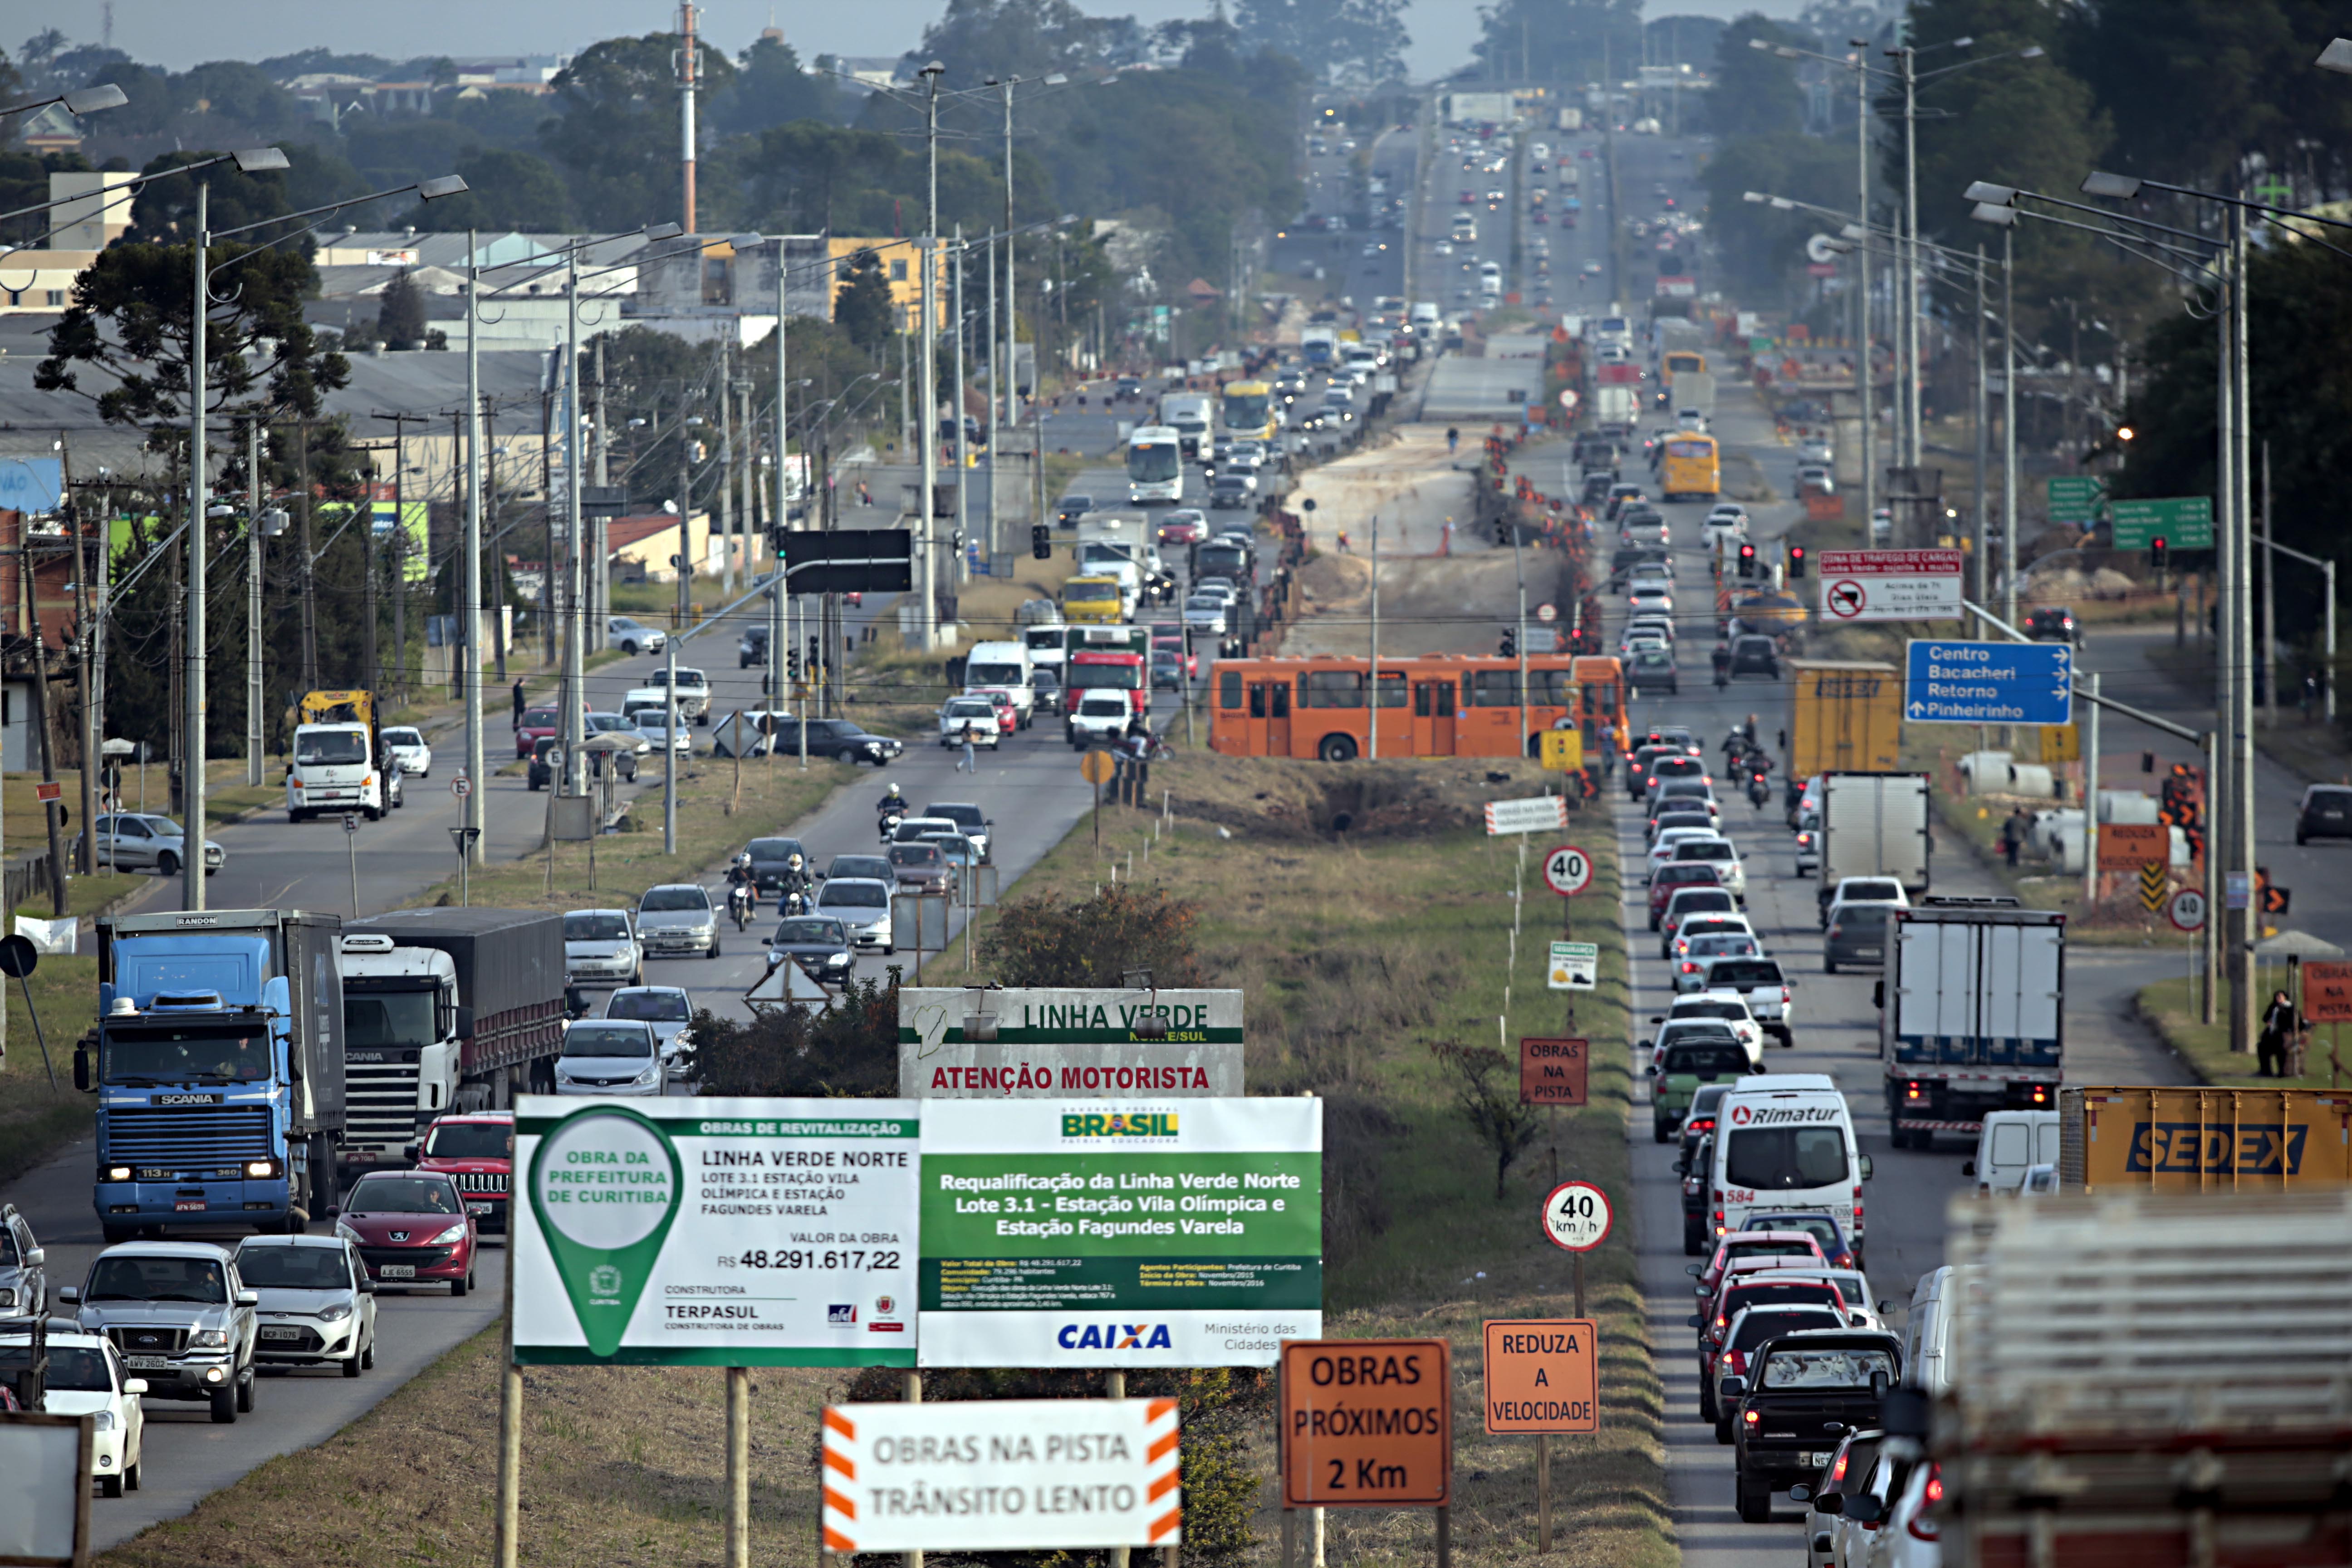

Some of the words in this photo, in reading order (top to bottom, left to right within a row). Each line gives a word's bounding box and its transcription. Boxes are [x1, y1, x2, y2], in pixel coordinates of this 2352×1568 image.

[1929, 646, 1989, 662] Centro
[1929, 665, 2016, 680] Bacacheri
[1928, 683, 1997, 698] Retorno
[1927, 701, 2024, 719] Pinheirinho
[1553, 856, 1582, 877] 40
[2178, 902, 2198, 914] 40
[177, 917, 216, 926] RANDON
[1554, 946, 1593, 954] SEGURANÇA
[2312, 968, 2352, 979] OBRA
[1024, 1004, 1109, 1029] LINHA
[1119, 1005, 1207, 1029] VERDE
[345, 1053, 382, 1062] CANIA
[1530, 1044, 1578, 1058] OBRAS
[931, 1062, 1053, 1095] ATENÇÃO
[1062, 1066, 1210, 1089] MOTORISTA
[1544, 1066, 1564, 1078] NA
[162, 1095, 213, 1104] SCANIA
[1534, 1086, 1572, 1098] PISTA
[1752, 1108, 1840, 1125] Rimatur
[700, 1122, 753, 1135] OBRAS
[757, 1122, 778, 1135] DE
[782, 1120, 901, 1137] REVITALIZAÇÃO
[1063, 1114, 1178, 1136] BRASIL
[2136, 1129, 2299, 1169] SEDEX
[567, 1151, 621, 1164] OBRA
[626, 1151, 649, 1164] DA
[703, 1151, 764, 1166] LINHA
[772, 1151, 836, 1167] VERDE
[843, 1151, 908, 1167] NORTE
[142, 1169, 162, 1177] 113
[549, 1171, 667, 1184] PREFEITURA
[701, 1173, 734, 1184] LOTE
[738, 1173, 757, 1184] 3.1
[764, 1171, 824, 1186] ESTAÇÃO
[828, 1173, 859, 1184] VILA
[940, 1173, 1085, 1194] Requalificação
[1089, 1173, 1114, 1189] da
[1120, 1173, 1174, 1189] Linha
[1179, 1173, 1239, 1189] Verde
[1245, 1173, 1300, 1189] Norte
[548, 1191, 574, 1203] DE
[578, 1191, 668, 1203] CURITIBA
[701, 1186, 768, 1200] OLÍMPICA
[773, 1189, 779, 1200] E
[784, 1186, 845, 1202] ESTAÇÃO
[1727, 1189, 1755, 1203] 584
[701, 1205, 772, 1215] FAGUNDES
[776, 1205, 828, 1215] VARELA
[956, 1197, 999, 1213] Lote
[1004, 1197, 1035, 1212] 3.1
[1056, 1197, 1133, 1216] Estação
[1137, 1196, 1175, 1212] Vila
[1181, 1196, 1267, 1216] Olímpica
[1273, 1200, 1284, 1211] e
[1560, 1195, 1593, 1219] 40
[996, 1220, 1073, 1239] Estação
[1079, 1220, 1175, 1239] Fagundes
[1181, 1220, 1244, 1235] Varela
[791, 1233, 835, 1243] VALOR
[839, 1233, 857, 1243] DA
[861, 1233, 899, 1244] OBRA
[718, 1256, 738, 1268] R$
[740, 1250, 900, 1272] 48.291.617,22
[666, 1286, 747, 1295] CONSTRUTORA
[666, 1306, 759, 1318] TERPASUL
[1058, 1324, 1171, 1349] CAIXA
[1205, 1323, 1269, 1334] Ministério
[1274, 1323, 1296, 1334] das
[1225, 1338, 1277, 1350] Cidades
[1504, 1334, 1578, 1353] REDUZA
[1311, 1355, 1420, 1386] OBRAS
[1535, 1368, 1548, 1387] A
[1294, 1401, 1439, 1436] PRÓXIMOS
[1493, 1401, 1591, 1421] VELOCIDADE
[873, 1435, 980, 1464] OBRAS
[990, 1435, 1036, 1462] NA
[1046, 1434, 1130, 1461] PISTA
[1328, 1459, 1345, 1489] 2
[1357, 1459, 1406, 1488] Km
[871, 1480, 1025, 1516] TRÂNSITO
[1036, 1485, 1136, 1513] LENTO
